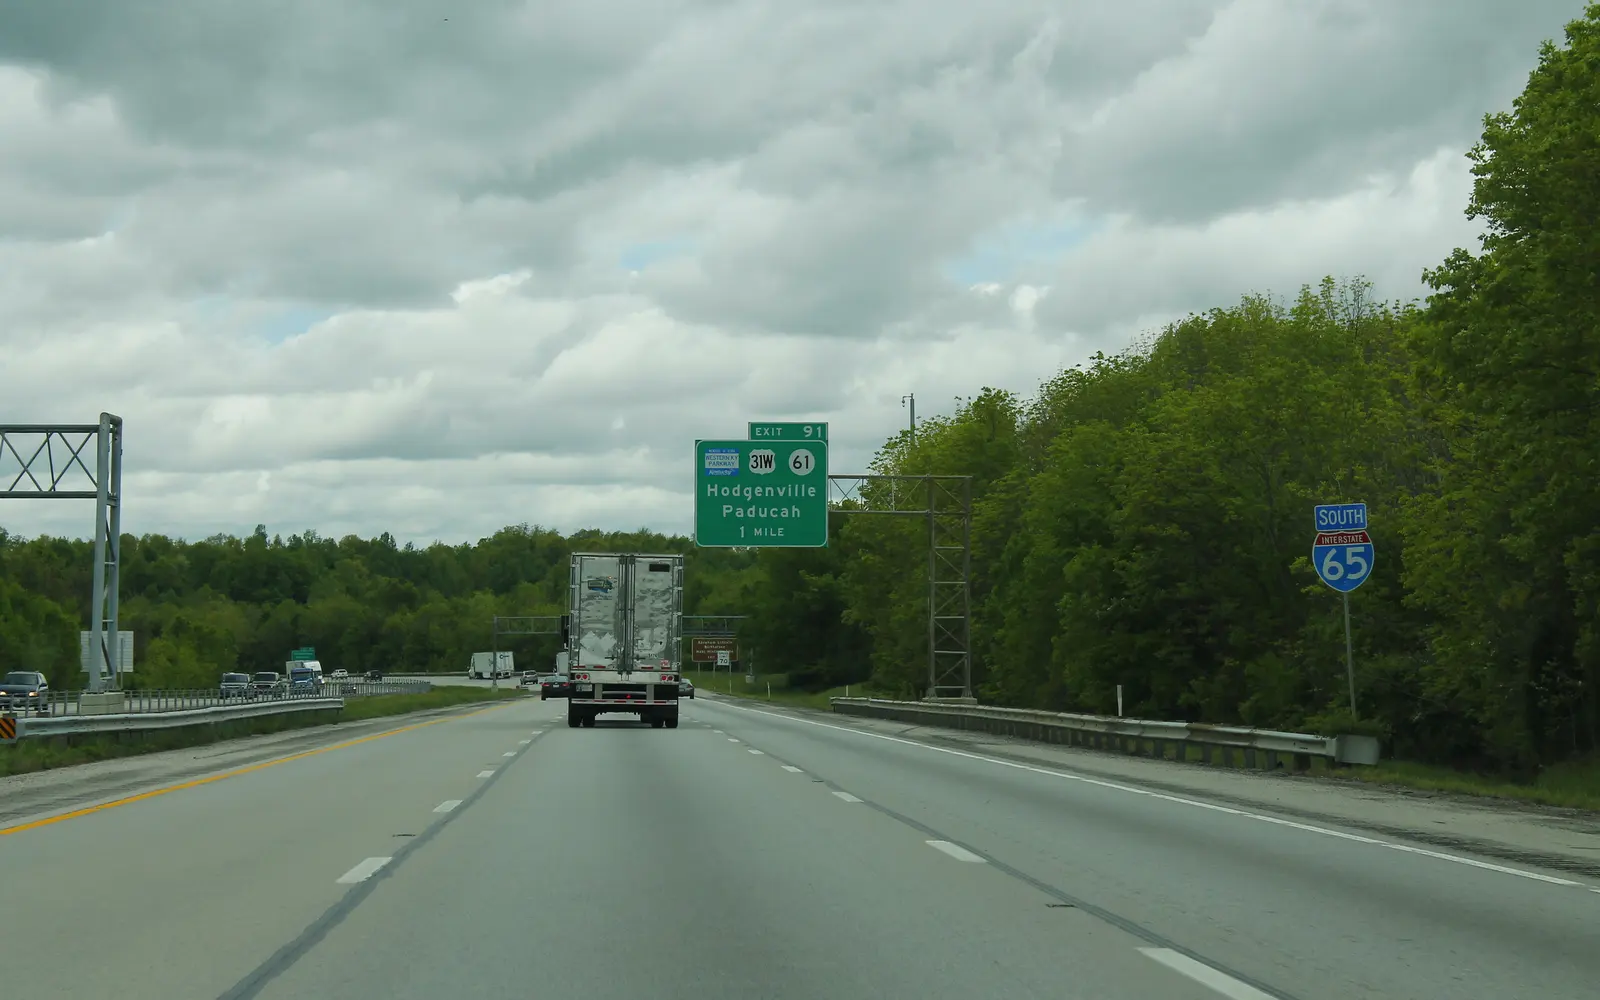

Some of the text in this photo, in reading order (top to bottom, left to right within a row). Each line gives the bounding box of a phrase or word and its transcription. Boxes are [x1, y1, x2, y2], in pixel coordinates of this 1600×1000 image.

[755, 425, 821, 438] EXIT 91
[750, 454, 774, 469] 31W
[792, 455, 809, 470] 61
[707, 484, 816, 501] Hodgenville
[722, 505, 801, 518] Paducah
[1319, 508, 1364, 526] SOUTH
[739, 526, 784, 538] 1 MILE
[1321, 534, 1364, 545] INTERSTATE
[1322, 546, 1368, 581] 65
